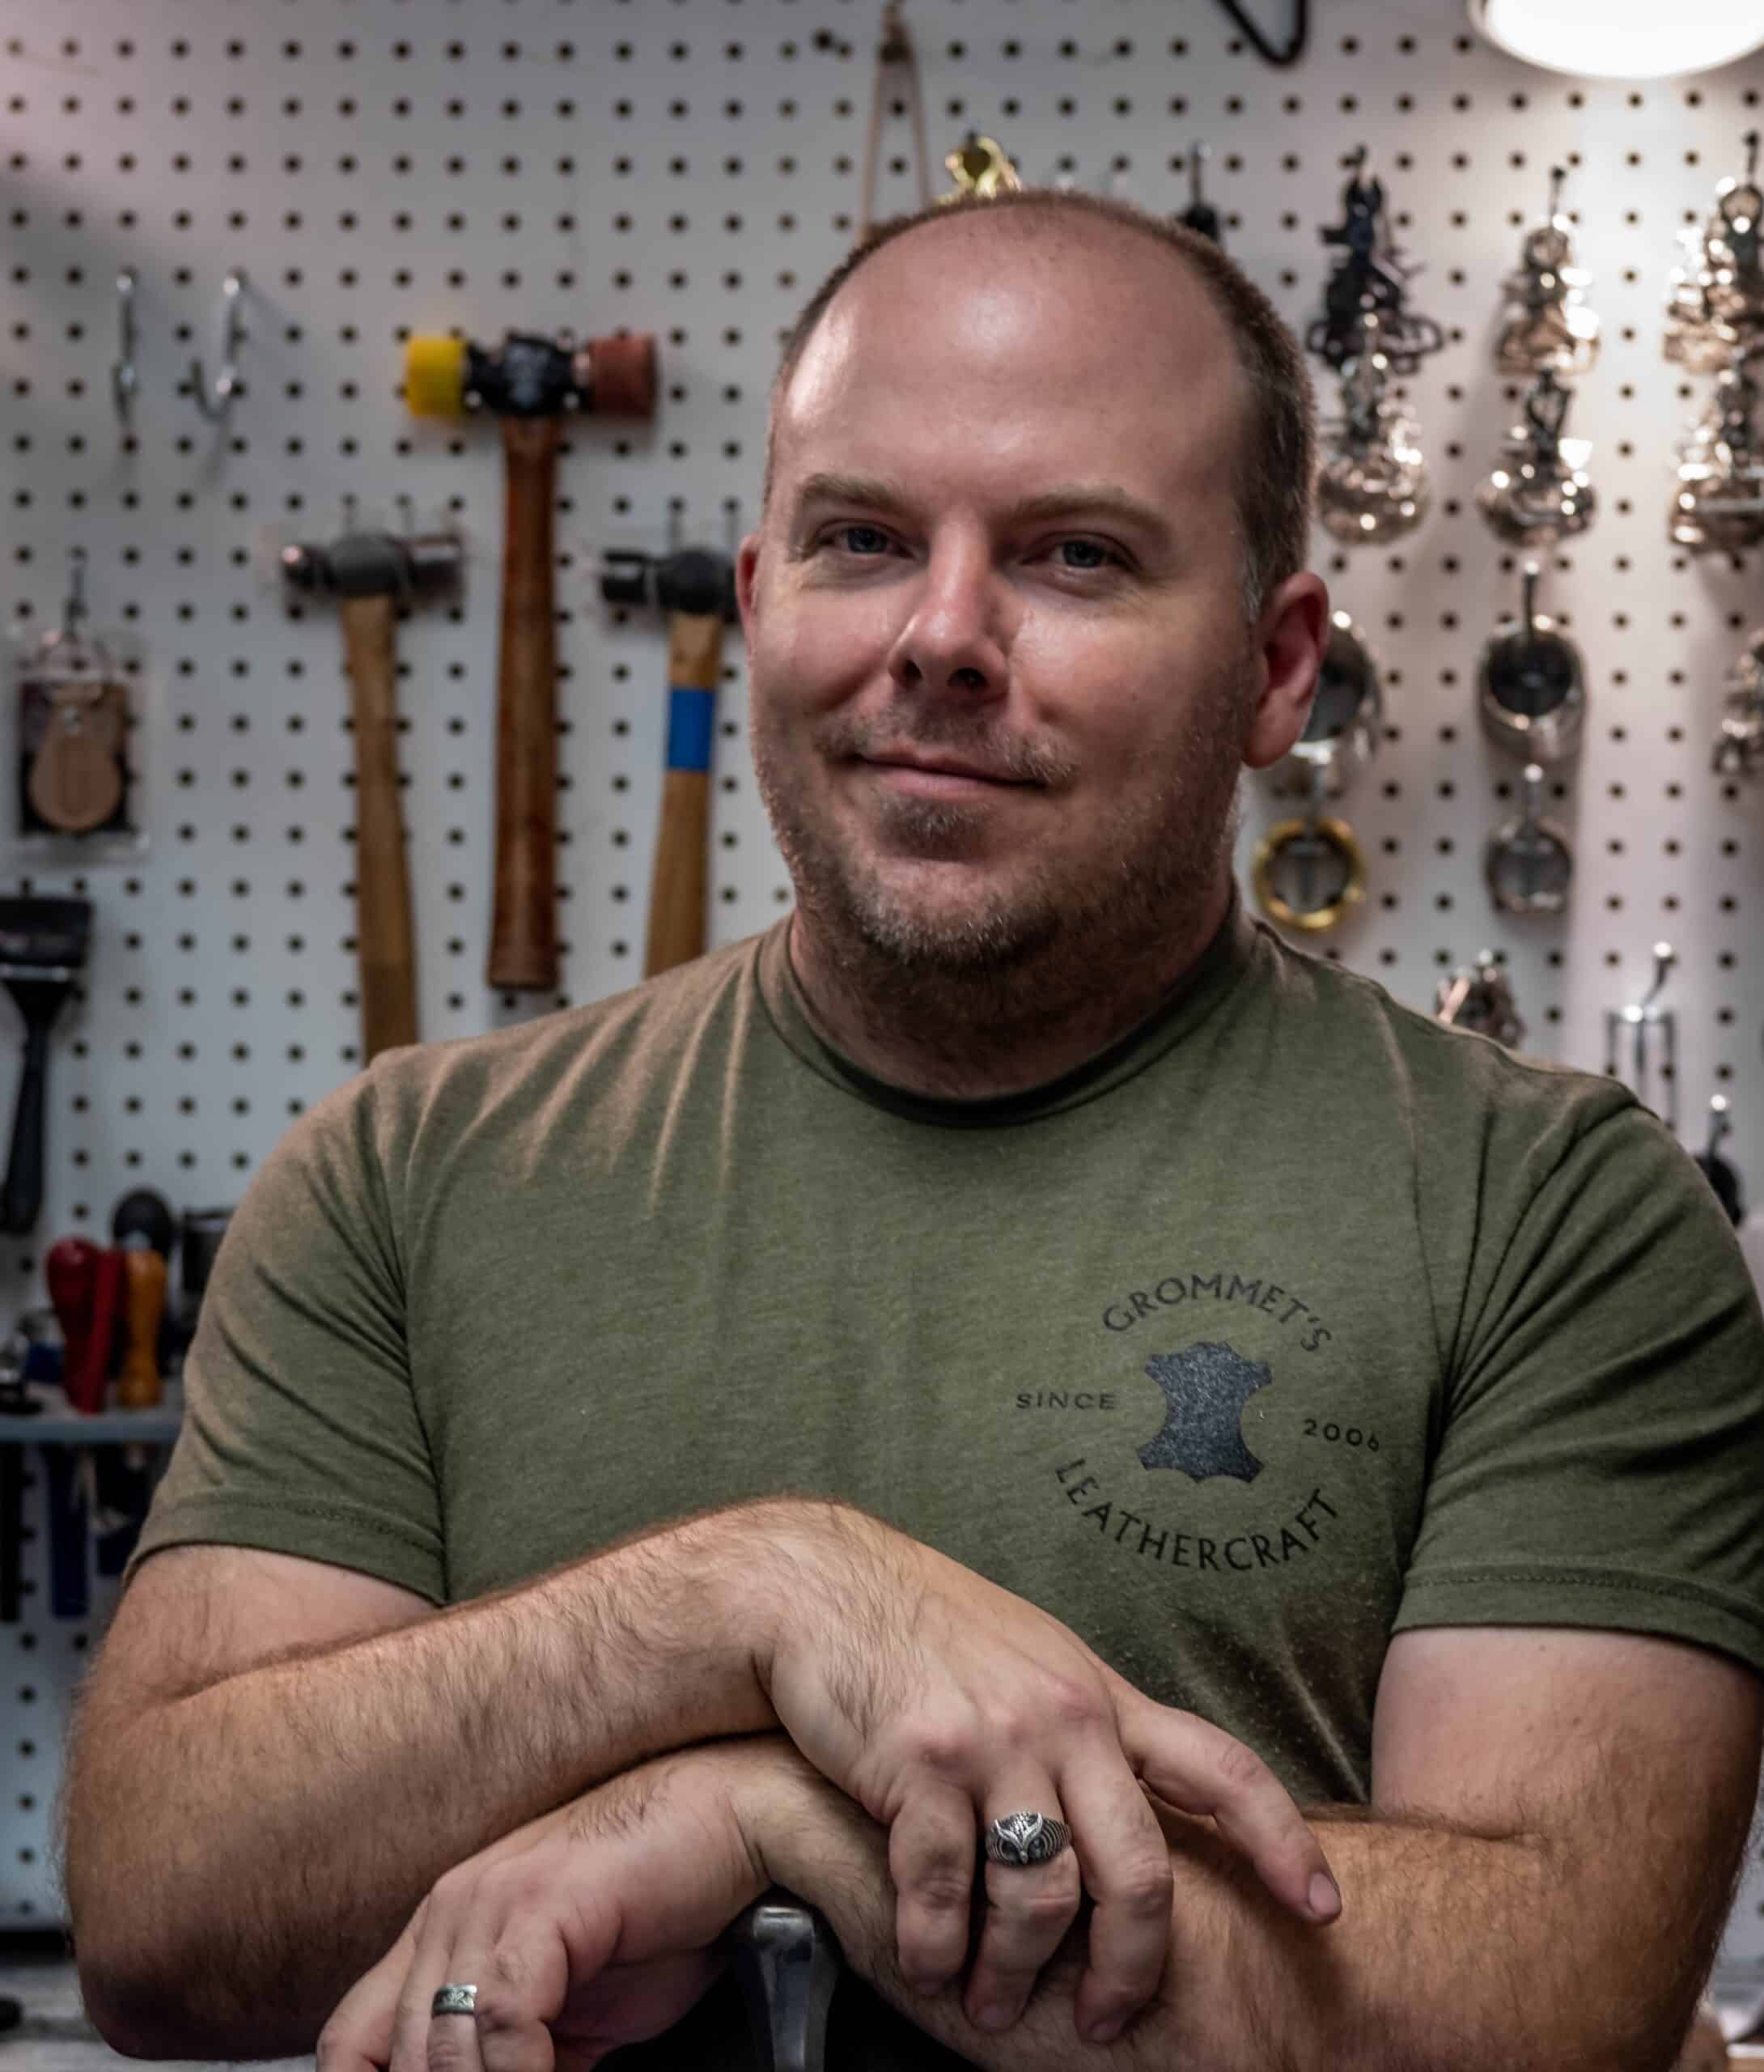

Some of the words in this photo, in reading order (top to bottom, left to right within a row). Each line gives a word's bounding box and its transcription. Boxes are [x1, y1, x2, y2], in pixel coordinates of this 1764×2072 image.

[1102, 1273, 1332, 1352] GROMMET'S
[1016, 1391, 1117, 1411] SINCE
[1304, 1418, 1380, 1452] 2006
[1054, 1458, 1338, 1571] LEATHERCRAFT
